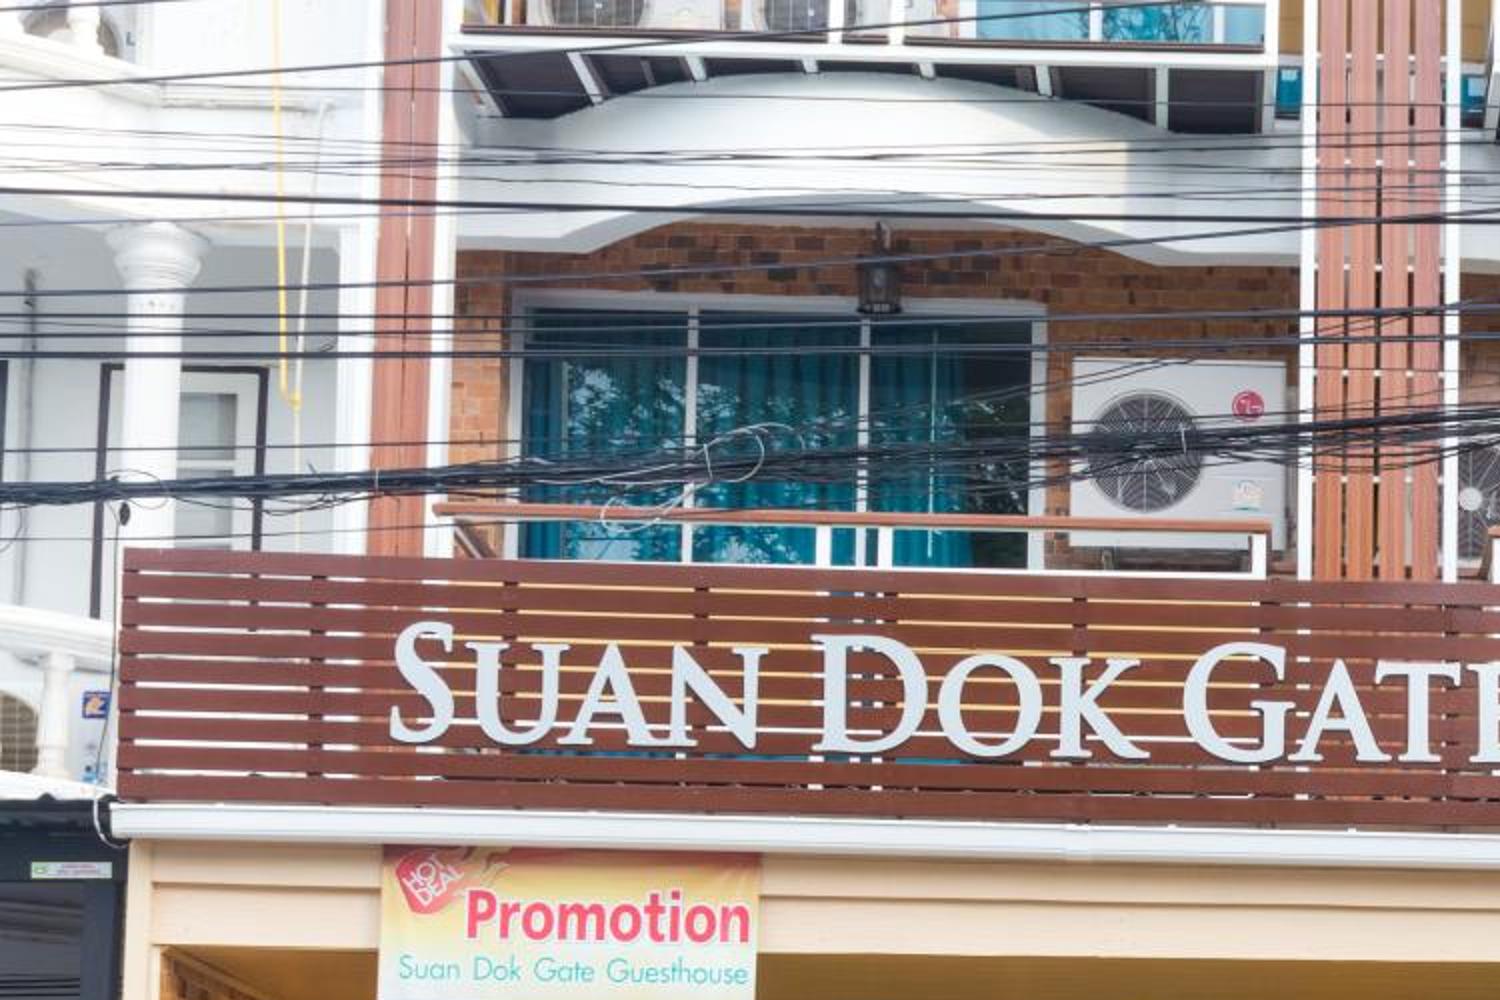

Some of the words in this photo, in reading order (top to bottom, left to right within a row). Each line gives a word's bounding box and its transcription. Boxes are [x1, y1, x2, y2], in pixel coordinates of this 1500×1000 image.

[388, 620, 770, 750] SUAN
[811, 633, 1151, 760] DOK
[466, 889, 751, 944] Promotion
[398, 955, 461, 982] Suan
[473, 955, 521, 983] Dok
[534, 956, 595, 984] Gate
[606, 958, 749, 986] Guesthouse
